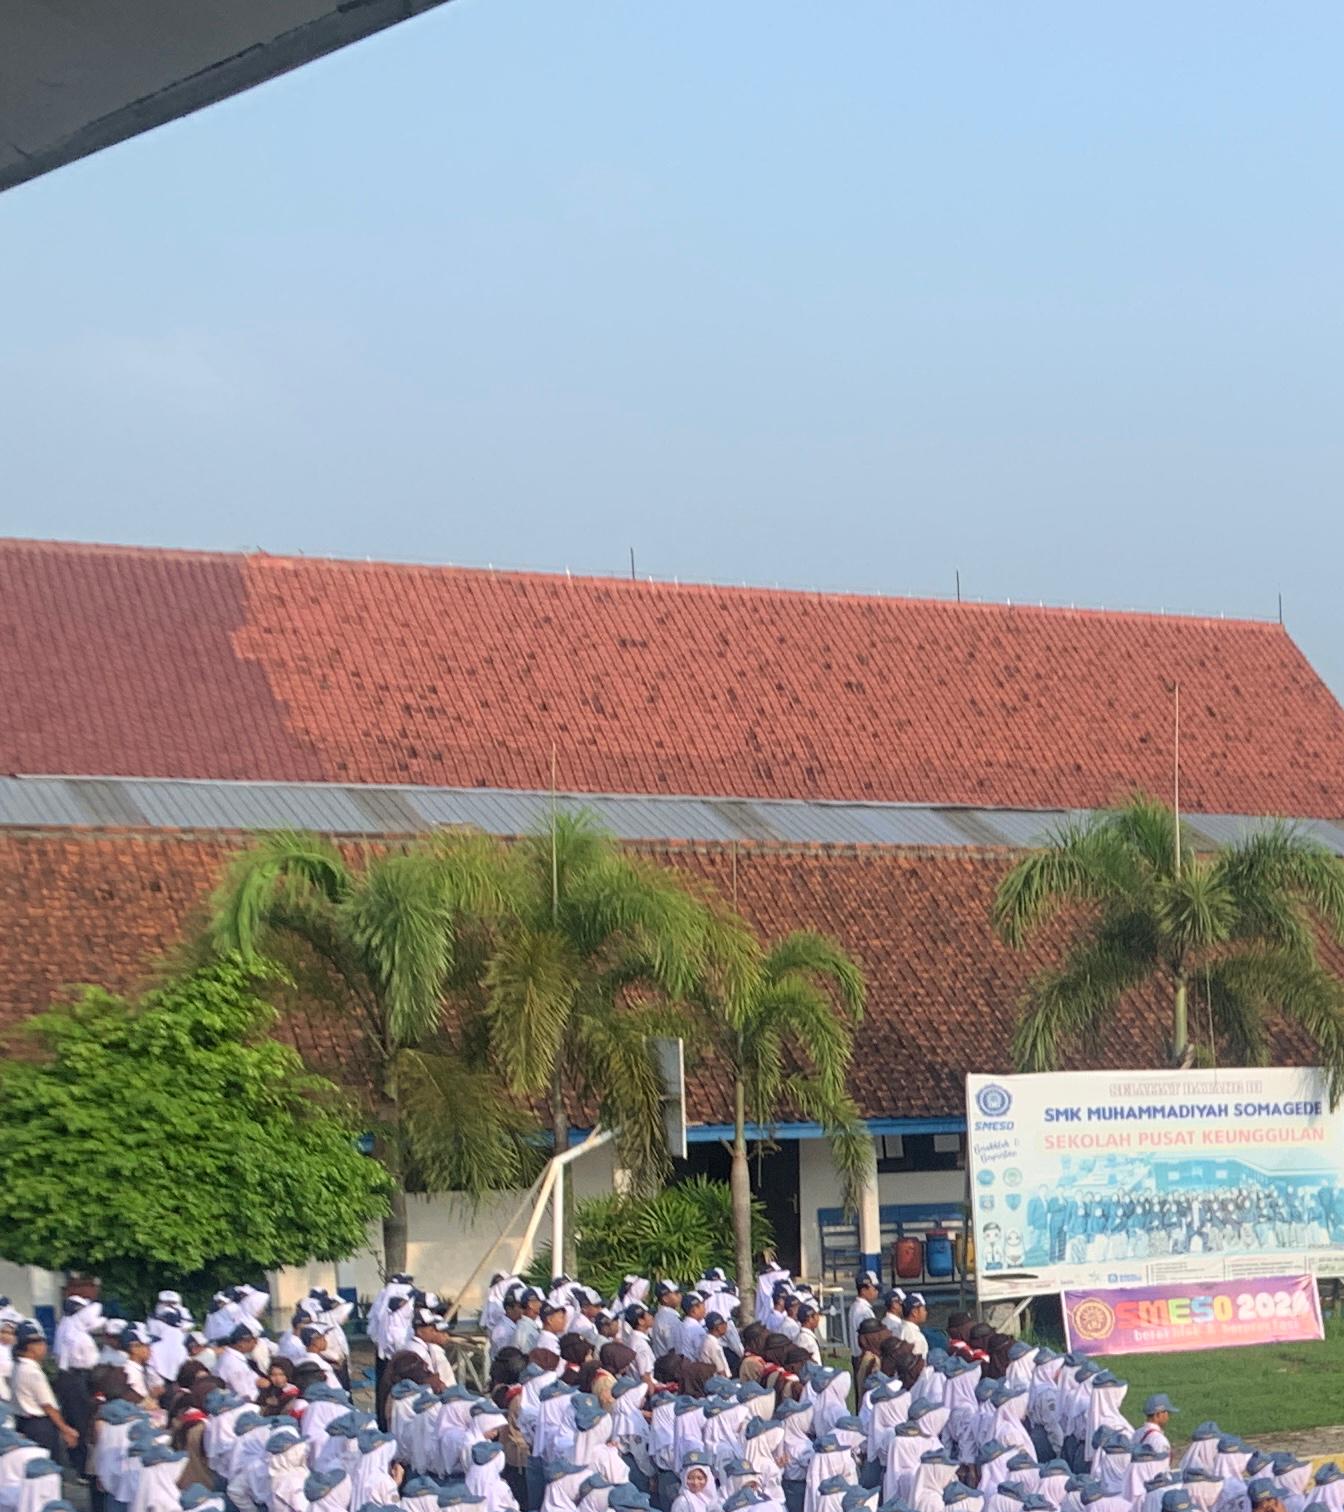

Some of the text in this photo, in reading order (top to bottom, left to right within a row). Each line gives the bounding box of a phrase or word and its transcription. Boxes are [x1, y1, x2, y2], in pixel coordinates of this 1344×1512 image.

[1044, 1101, 1322, 1122] SMK MUHAMMADIYAH SOMAGEDE
[975, 1121, 1015, 1131] SMESO
[1044, 1127, 1325, 1150] SEKOLAH PUSAT KEUNGGULAN
[1115, 1295, 1233, 1329] SMESO
